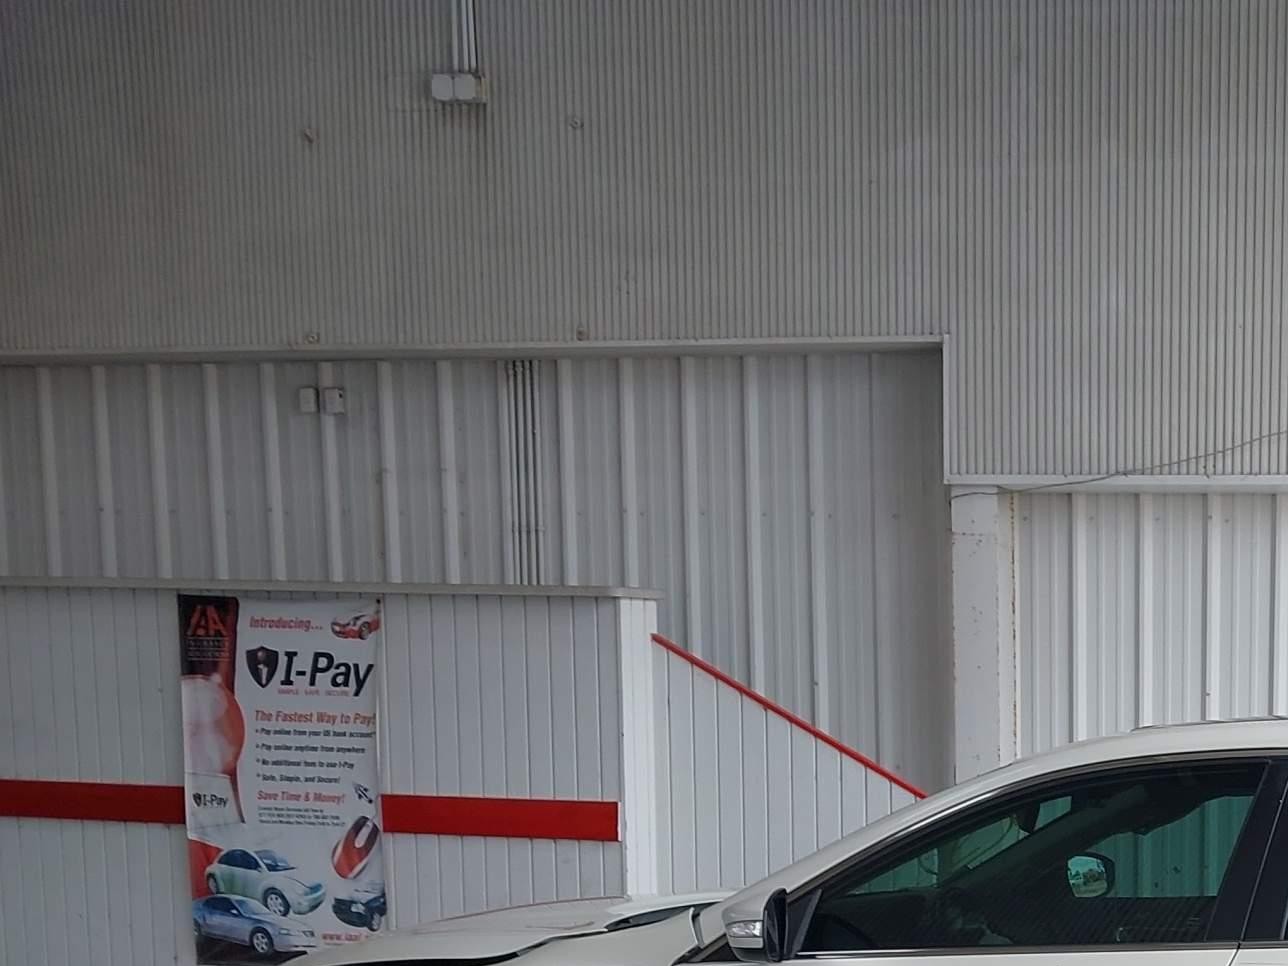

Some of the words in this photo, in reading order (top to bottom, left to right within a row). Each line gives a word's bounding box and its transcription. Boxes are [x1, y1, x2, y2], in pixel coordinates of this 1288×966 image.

[249, 616, 323, 632] Introducing...
[280, 651, 374, 697] I-Pay
[256, 710, 272, 721] The
[275, 711, 313, 723] Fastest
[317, 712, 337, 725] Way
[341, 713, 351, 724] to
[203, 793, 229, 808] I-Pay
[257, 790, 278, 800] Save
[281, 791, 301, 801] Time
[304, 792, 311, 802] &
[314, 793, 345, 805] Money!
